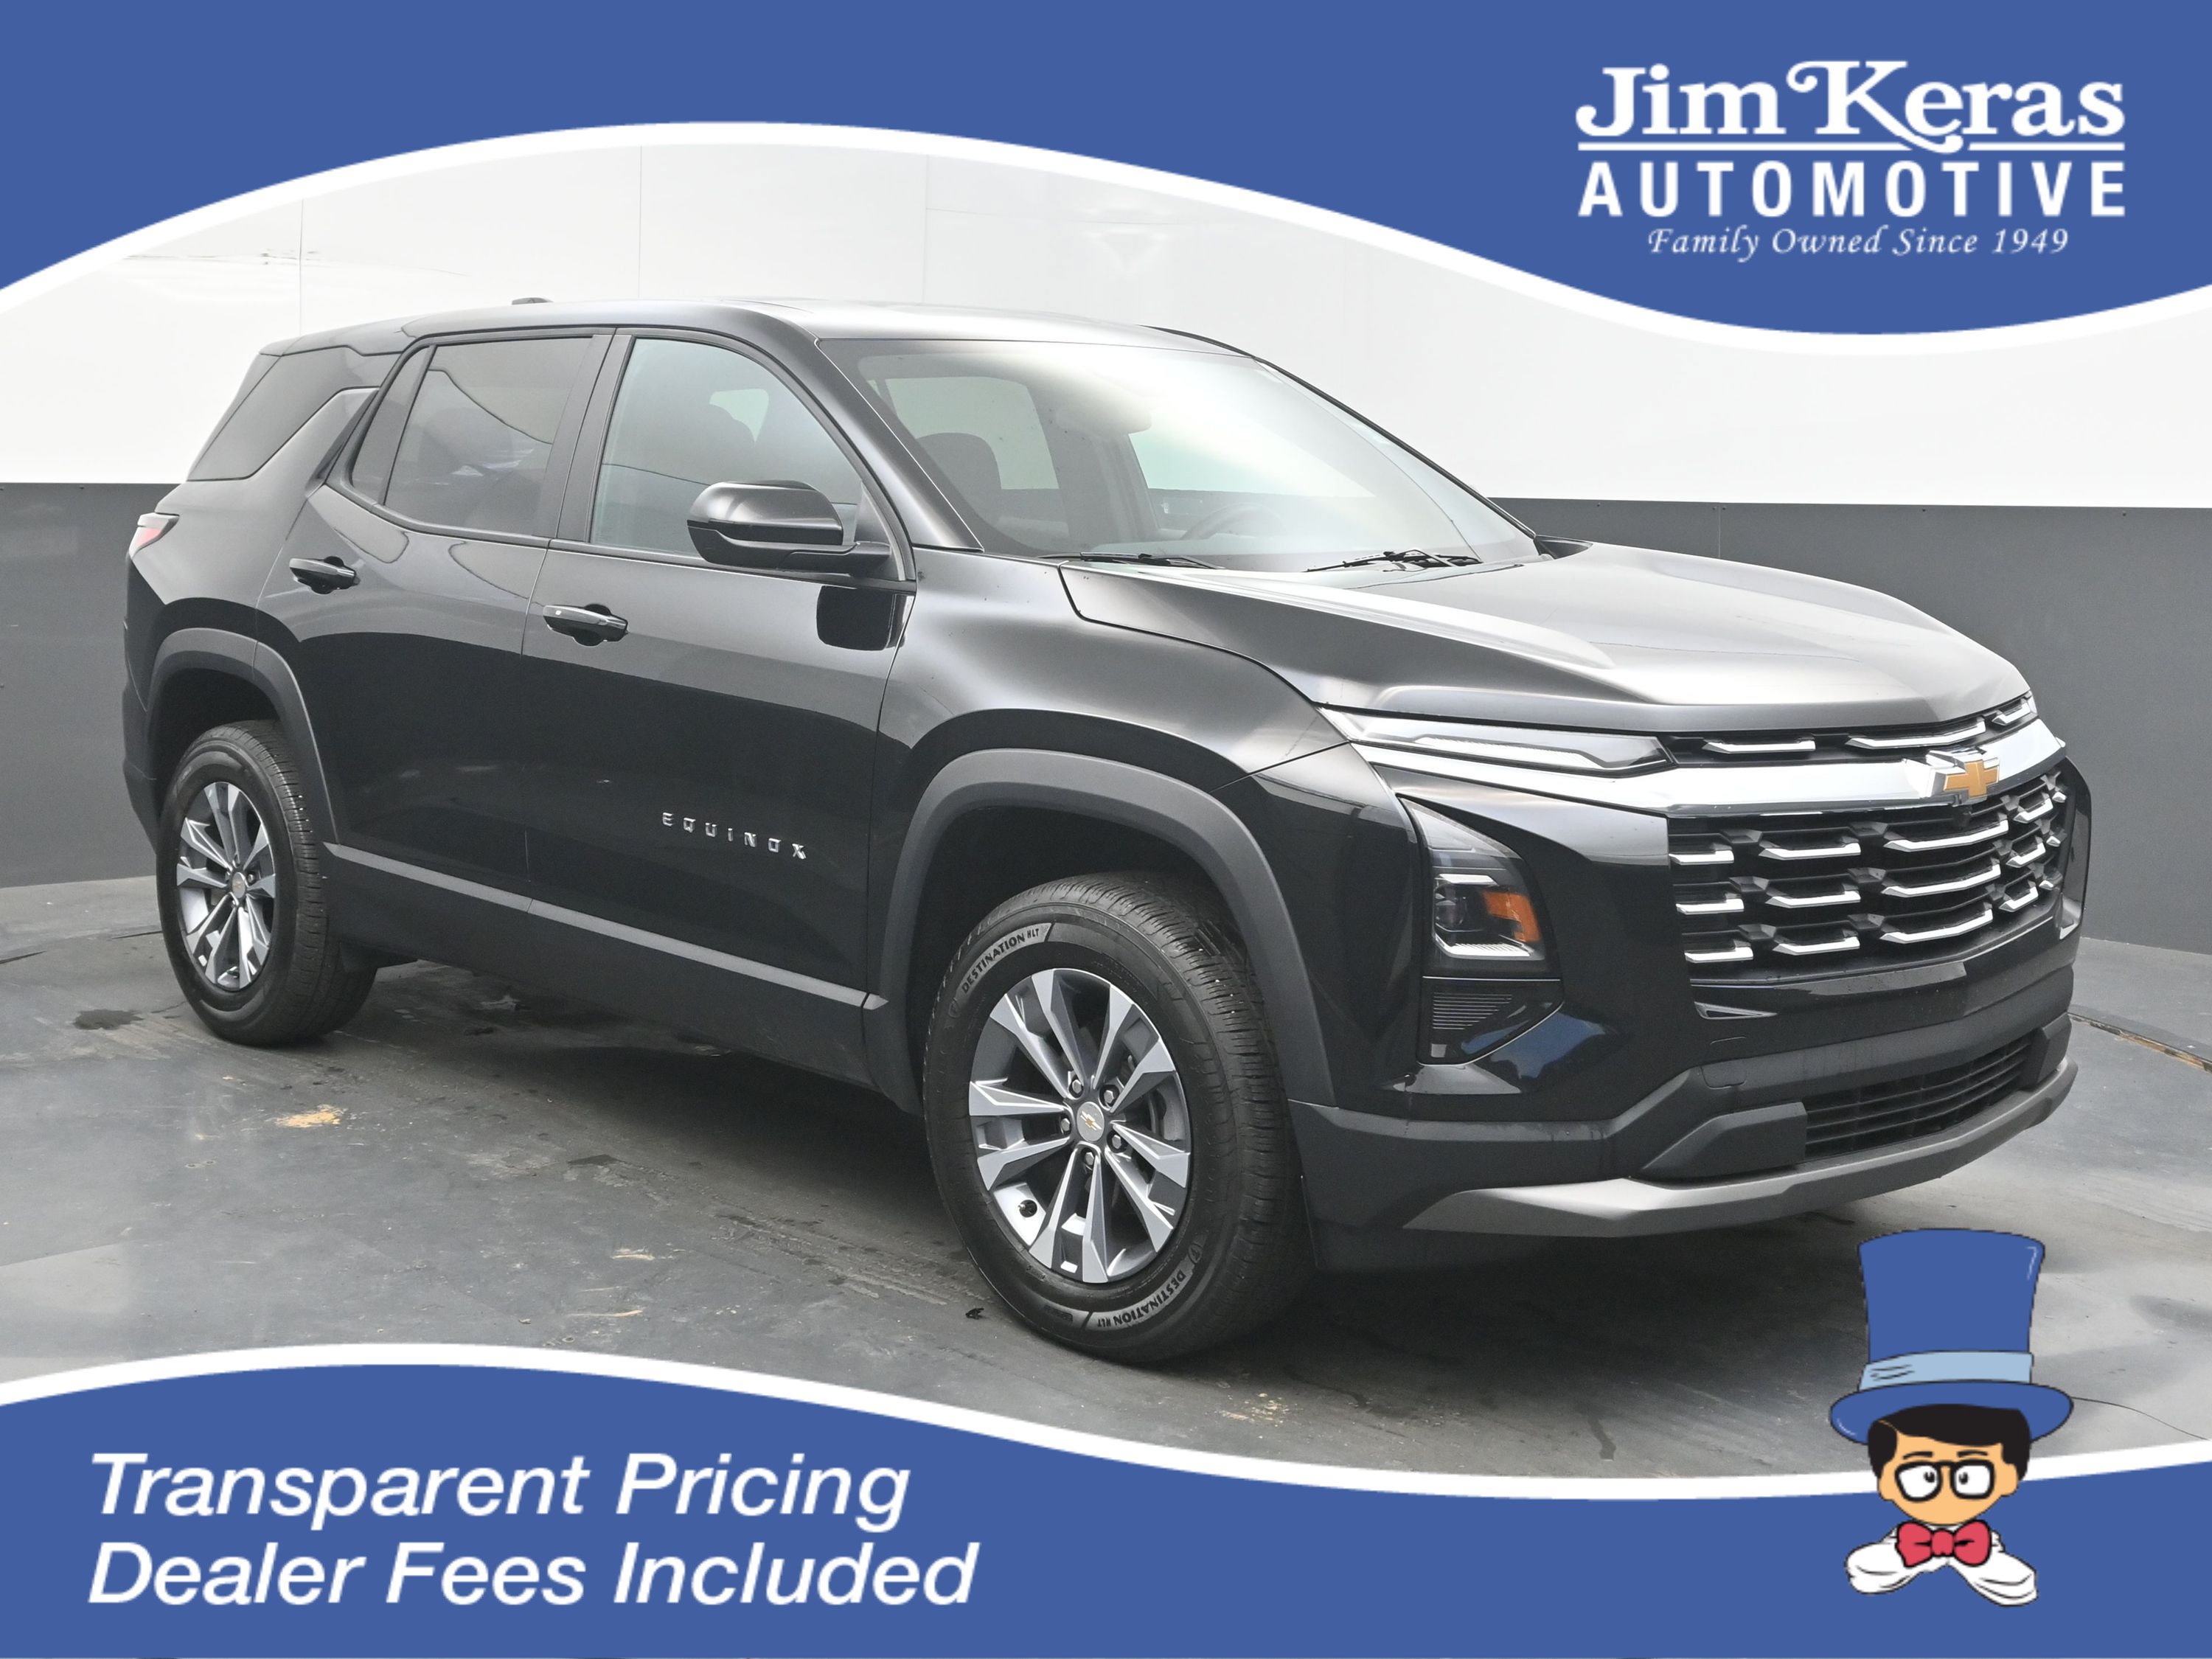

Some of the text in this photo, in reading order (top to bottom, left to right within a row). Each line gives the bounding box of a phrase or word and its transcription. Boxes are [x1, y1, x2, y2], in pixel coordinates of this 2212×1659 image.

[662, 812, 807, 860] EQUINOX
[961, 933, 1026, 994] DESTINATION
[1112, 1269, 1186, 1326] DESTINATION
